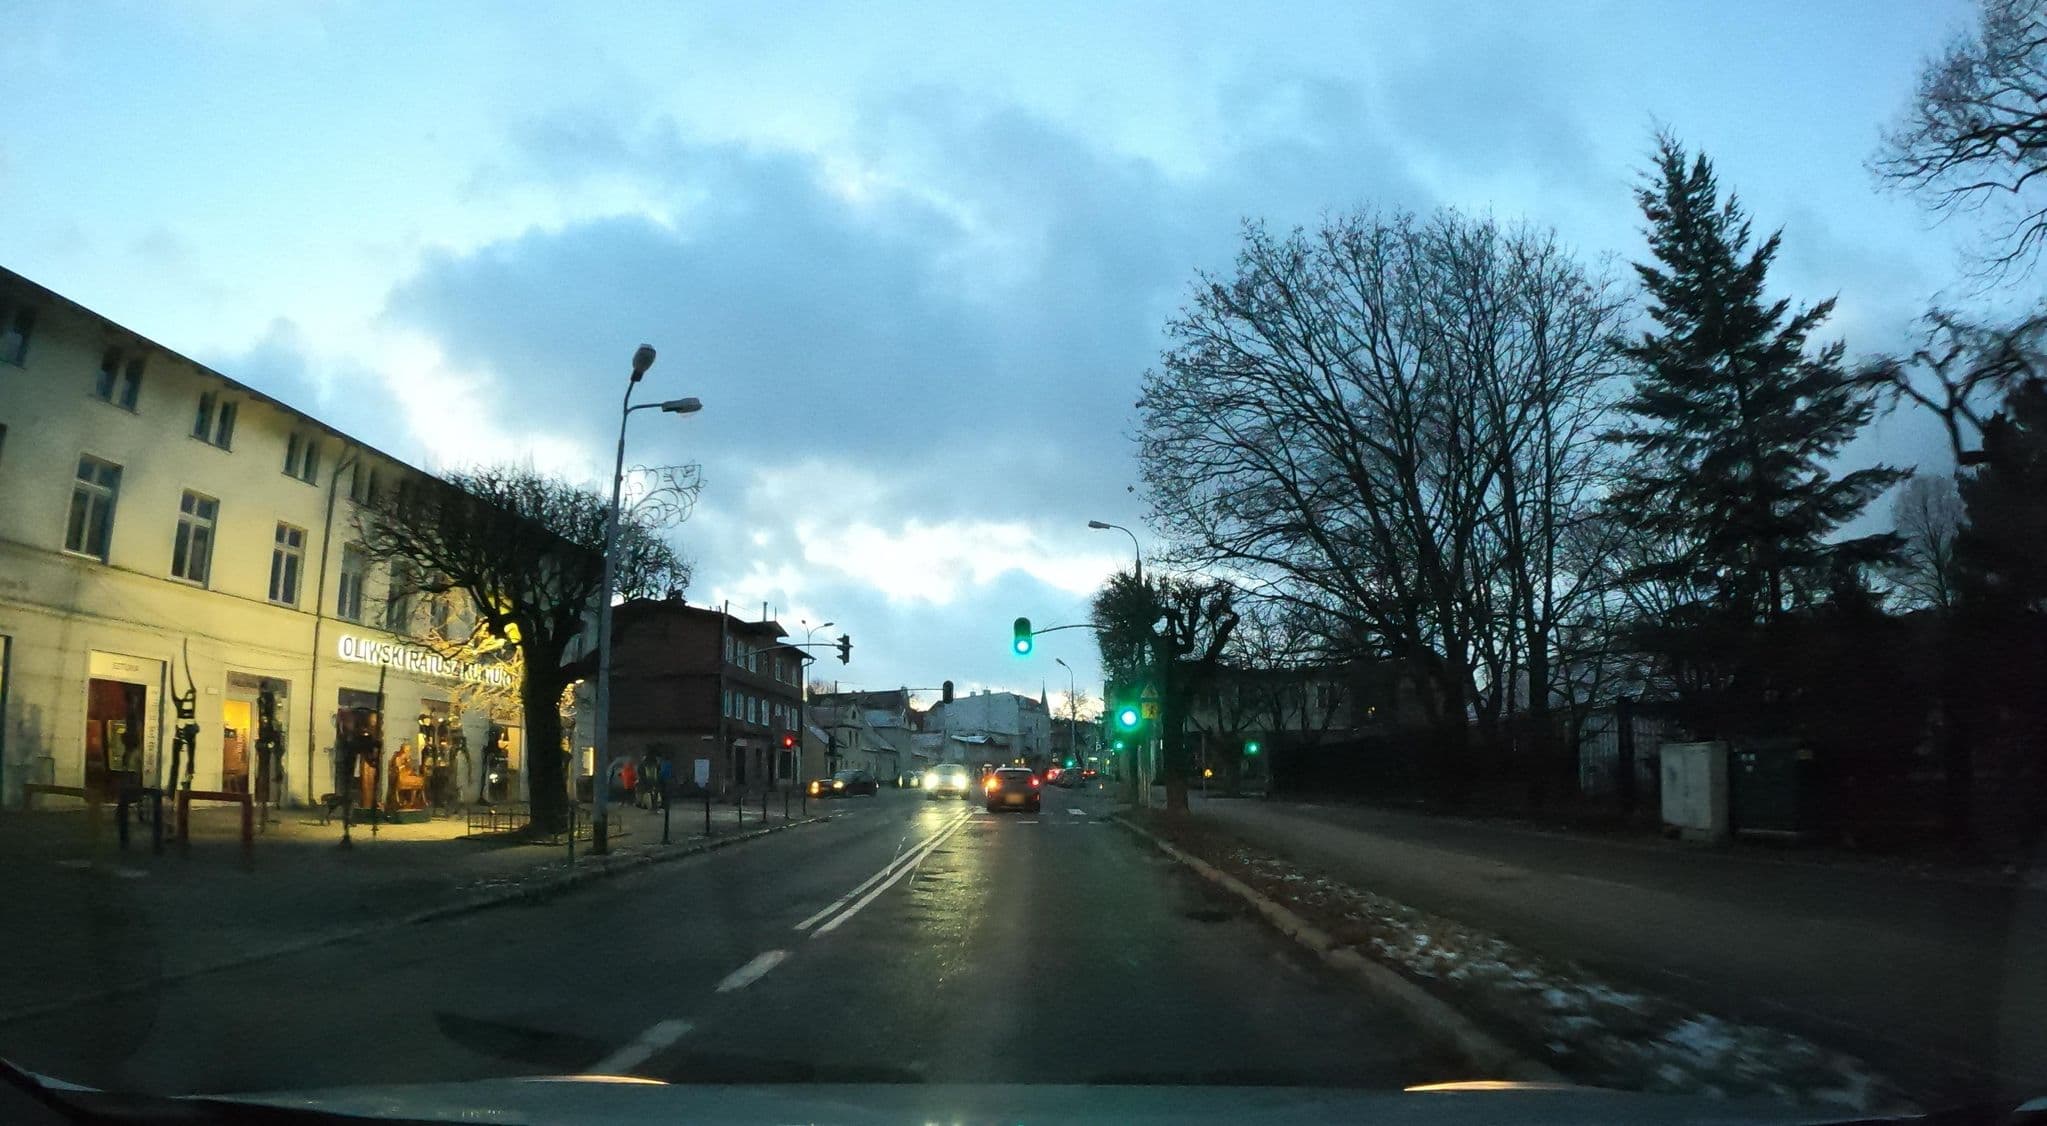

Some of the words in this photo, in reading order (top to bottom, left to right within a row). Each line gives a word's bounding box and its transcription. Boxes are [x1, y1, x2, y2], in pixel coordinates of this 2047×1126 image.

[343, 636, 405, 667] OLIWSKI
[409, 650, 460, 677] RATUSZ
[461, 661, 517, 685] KULTUR
